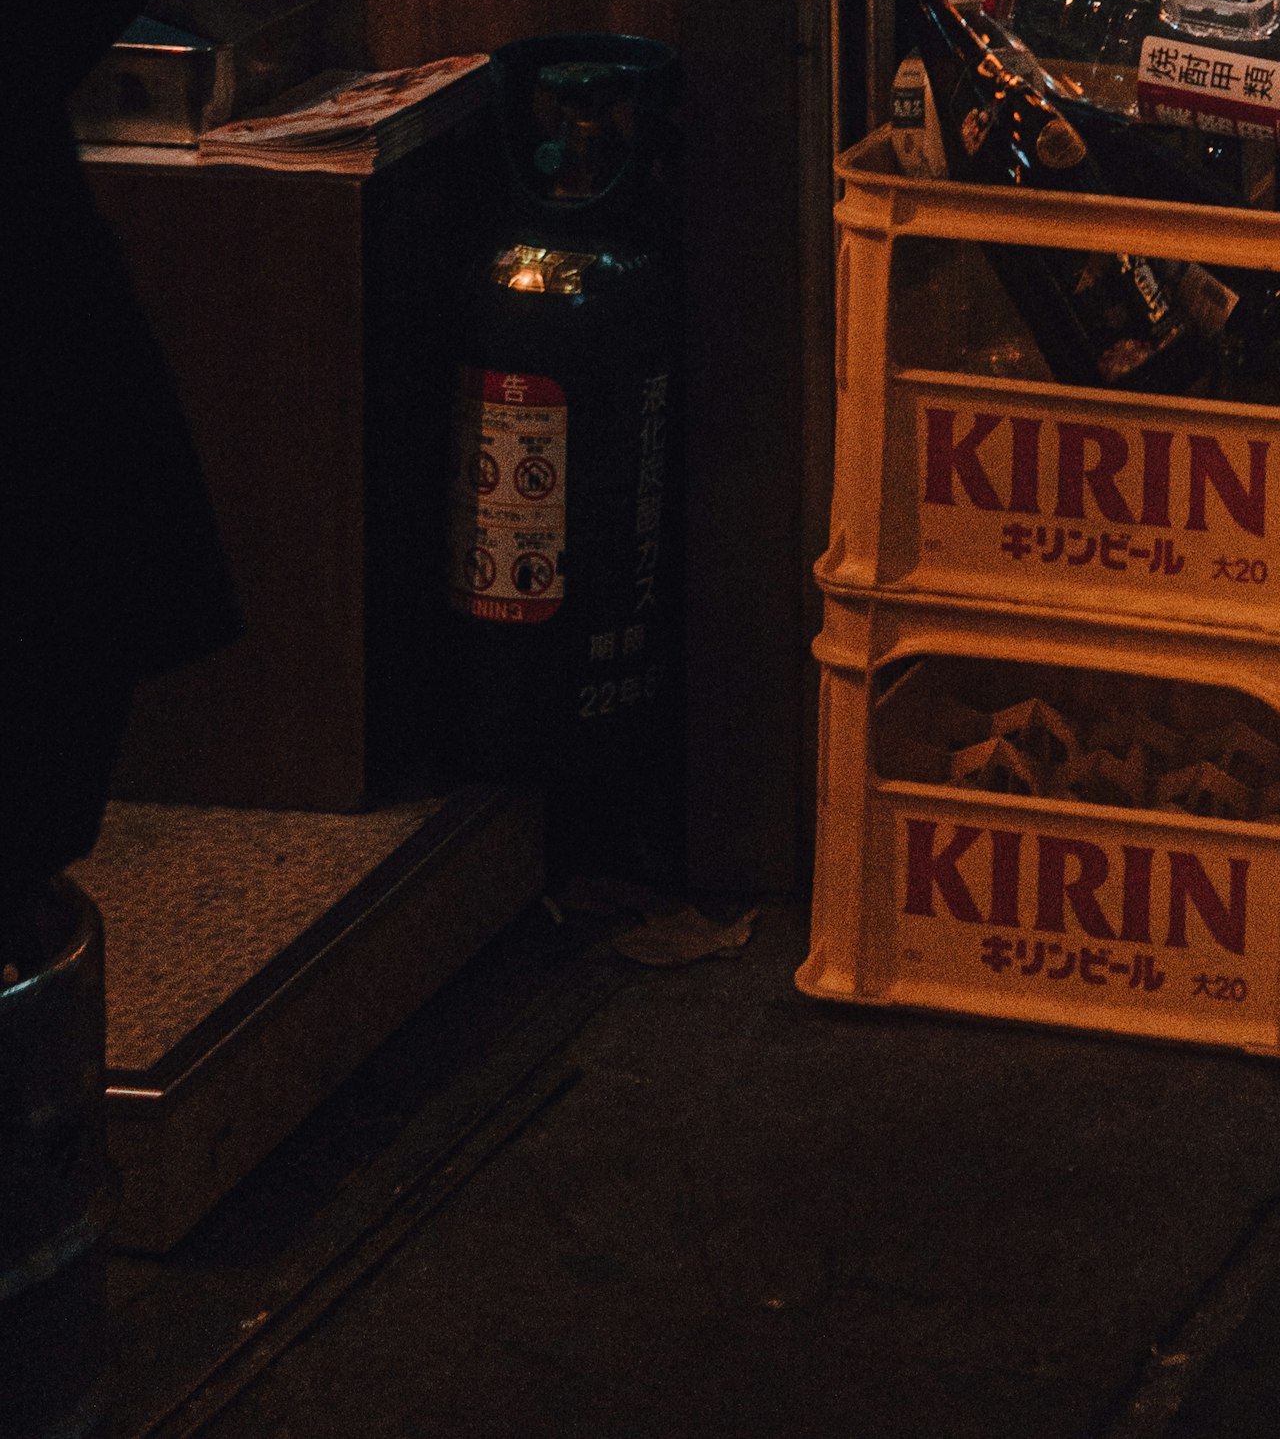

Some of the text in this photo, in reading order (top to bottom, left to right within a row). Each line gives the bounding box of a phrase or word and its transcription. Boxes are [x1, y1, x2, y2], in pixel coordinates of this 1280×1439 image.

[1146, 45, 1277, 103] 焼酎甲類
[924, 408, 1271, 538] KIRIN
[1001, 522, 1185, 576] キリンビール
[903, 818, 1251, 956] KIRIN
[981, 934, 1166, 992] キリンビール
